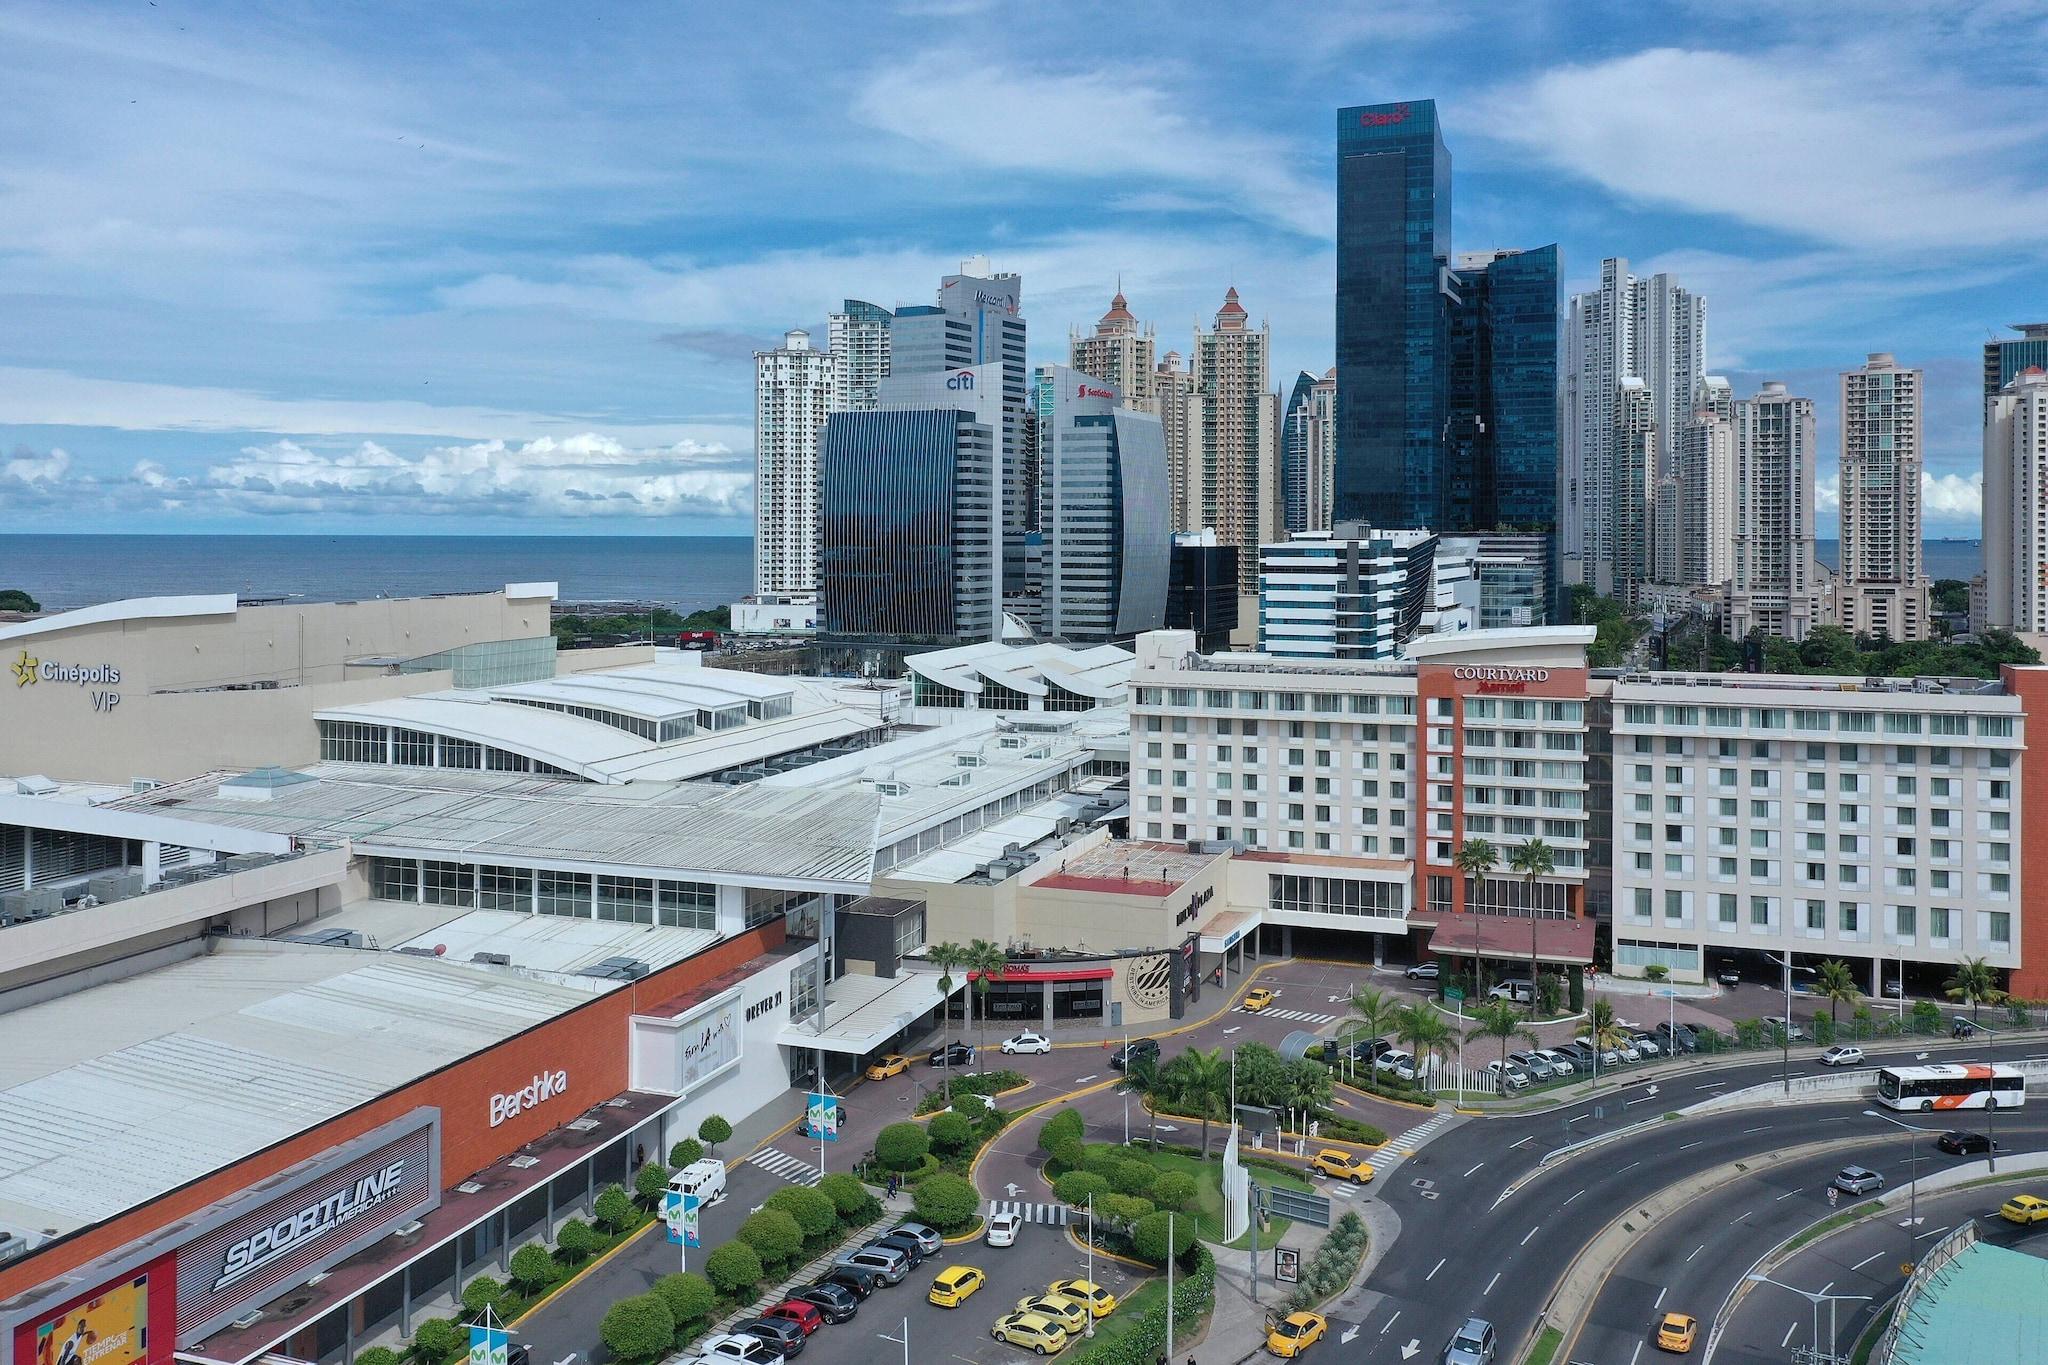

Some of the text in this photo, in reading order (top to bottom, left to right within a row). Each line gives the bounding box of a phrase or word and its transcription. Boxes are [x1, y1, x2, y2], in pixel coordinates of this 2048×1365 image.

[1361, 112, 1403, 127] Claro
[947, 372, 974, 390] citi
[41, 661, 121, 686] Cinépolis
[1454, 667, 1549, 682] COURTYARD
[91, 691, 120, 712] VIP
[774, 991, 782, 1008] 21
[490, 1070, 567, 1128] Bershka
[223, 1159, 405, 1275] SPORTLINE
[325, 1194, 382, 1232] AMERICA
